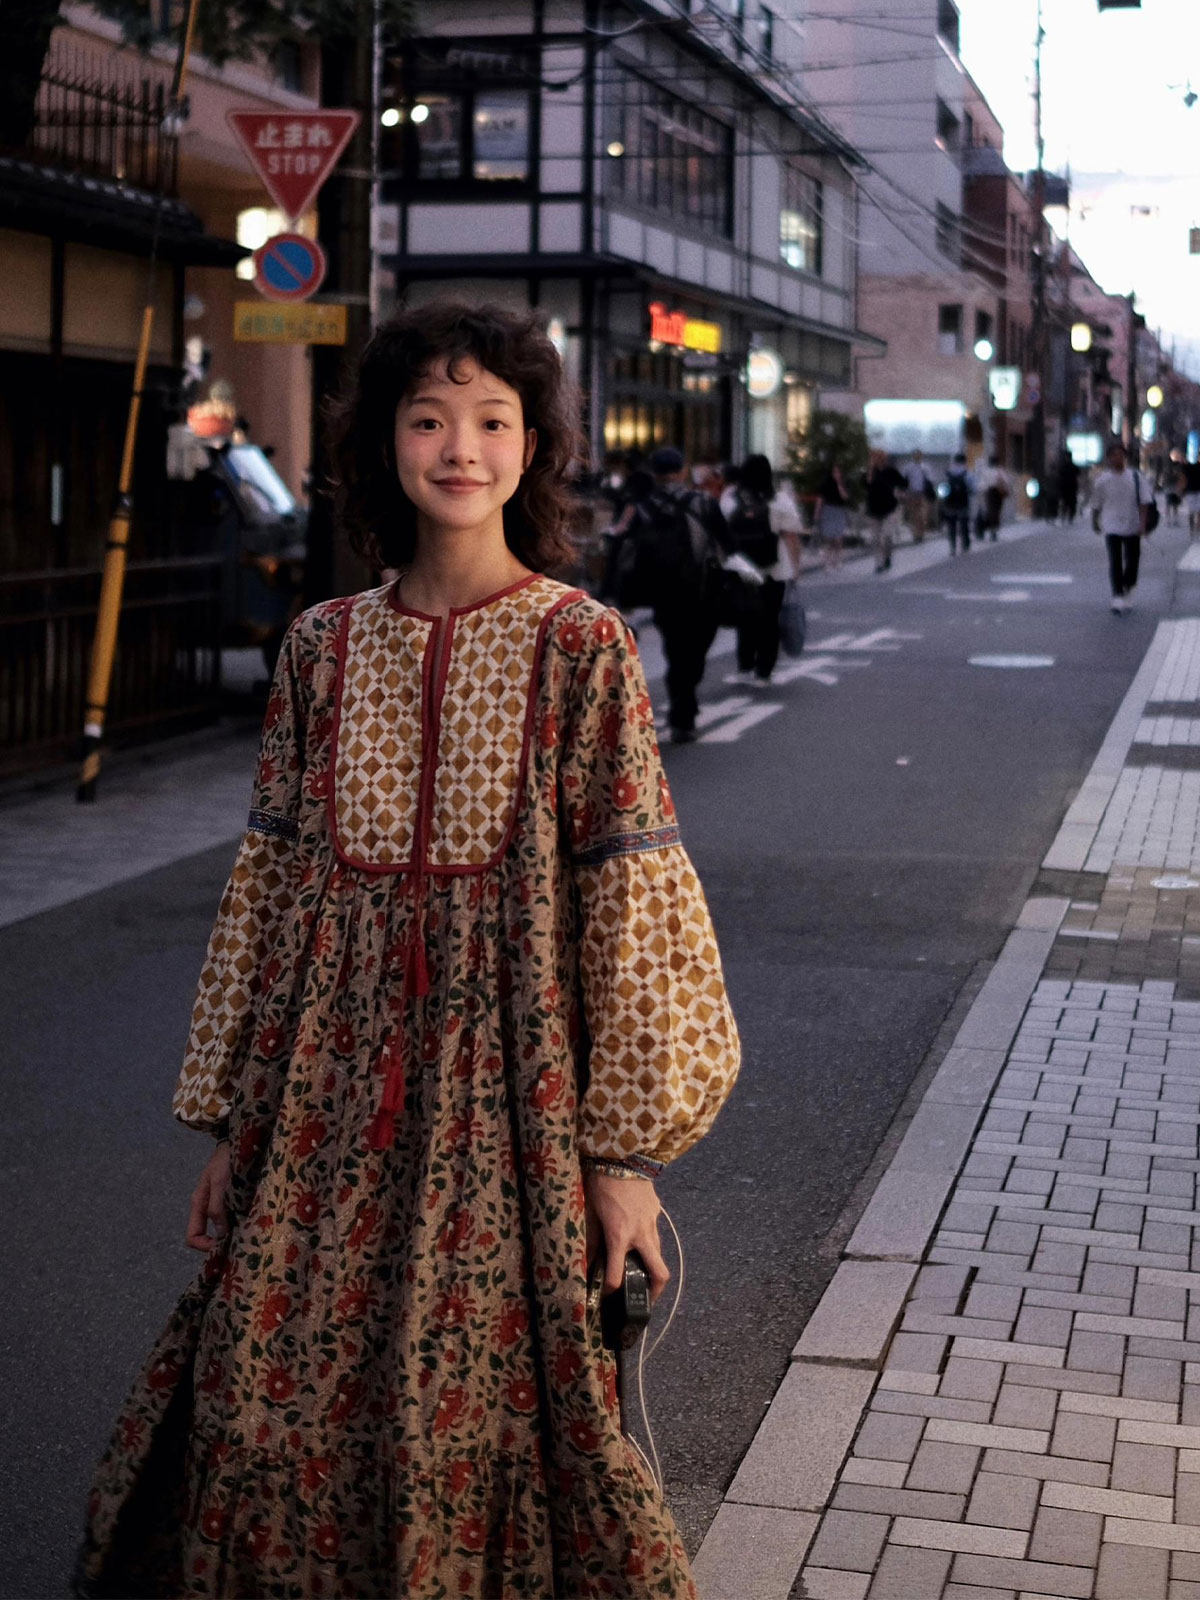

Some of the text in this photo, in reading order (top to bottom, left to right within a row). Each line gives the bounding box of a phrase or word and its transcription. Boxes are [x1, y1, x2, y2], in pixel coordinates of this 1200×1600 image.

[254, 122, 333, 148] 止まれ
[267, 153, 321, 175] STOP
